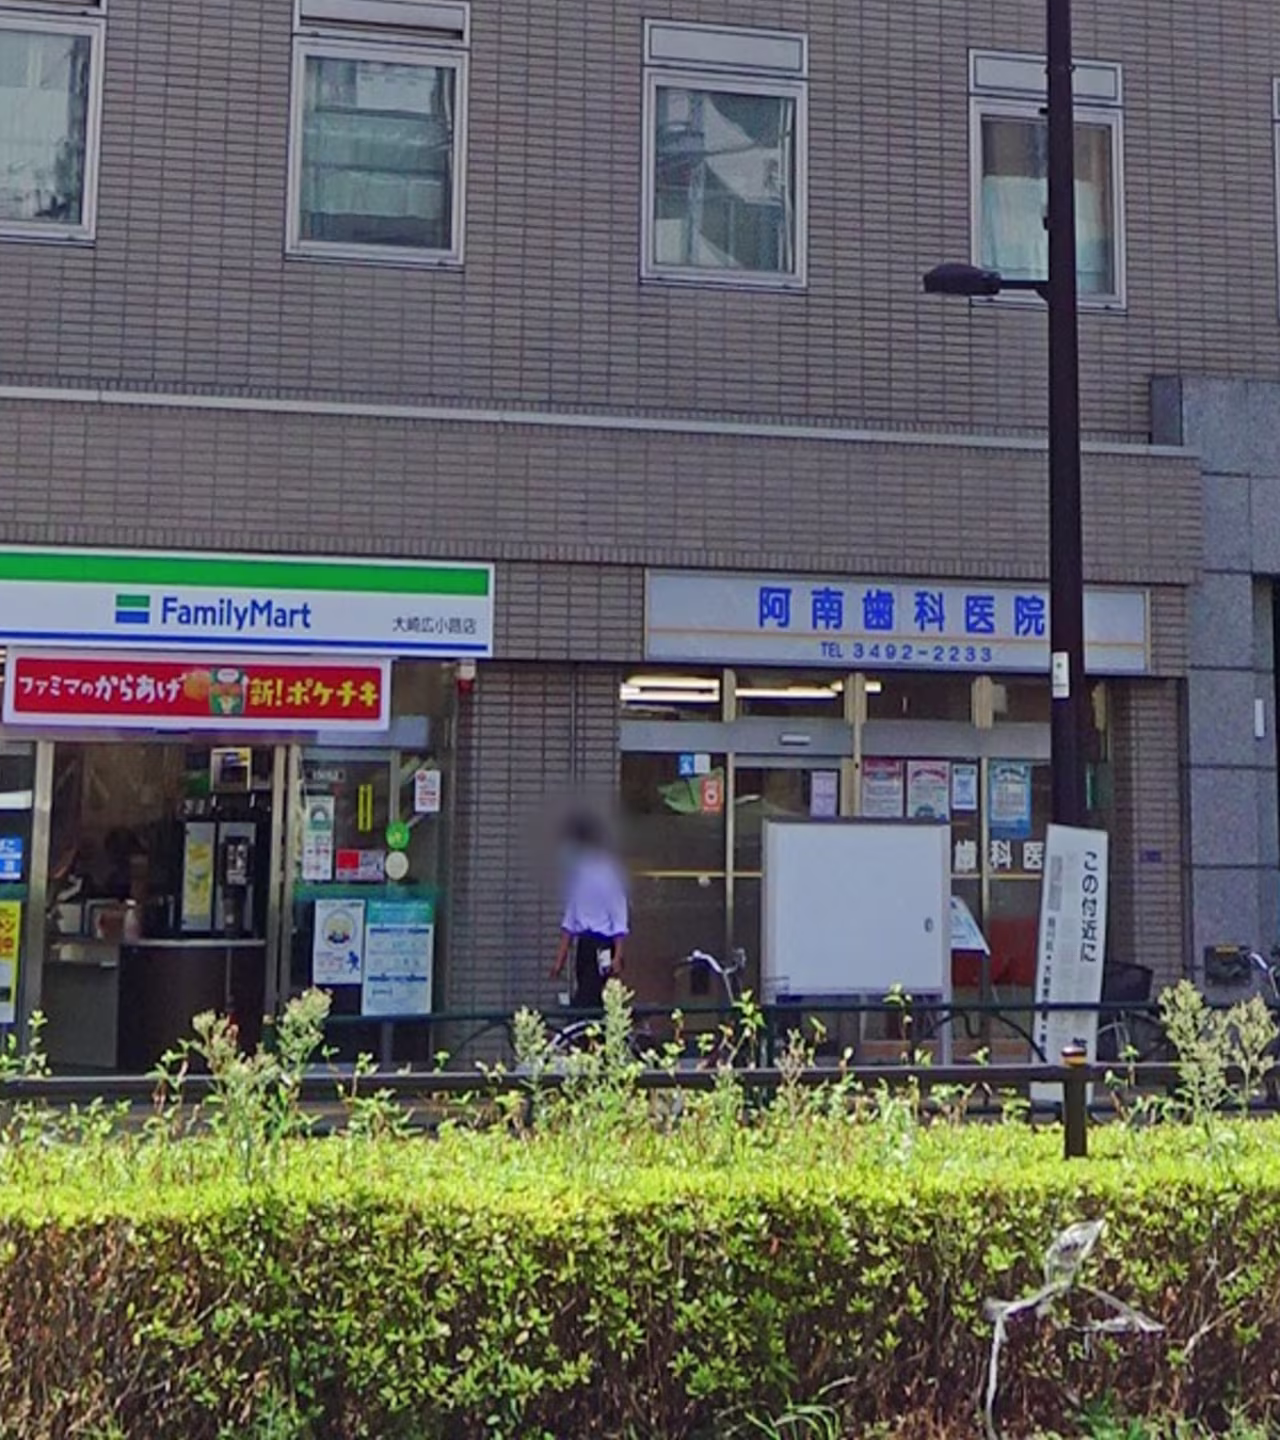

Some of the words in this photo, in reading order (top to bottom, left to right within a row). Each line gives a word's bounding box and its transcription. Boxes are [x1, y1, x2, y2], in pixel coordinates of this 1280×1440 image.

[161, 596, 312, 630] FamilyMart
[758, 585, 1046, 636] 阿南歯科医院
[821, 641, 844, 659] TEL
[853, 643, 994, 663] 3492-2233
[18, 673, 183, 704] ファミマのからあげ
[1080, 850, 1099, 963] この付近に
